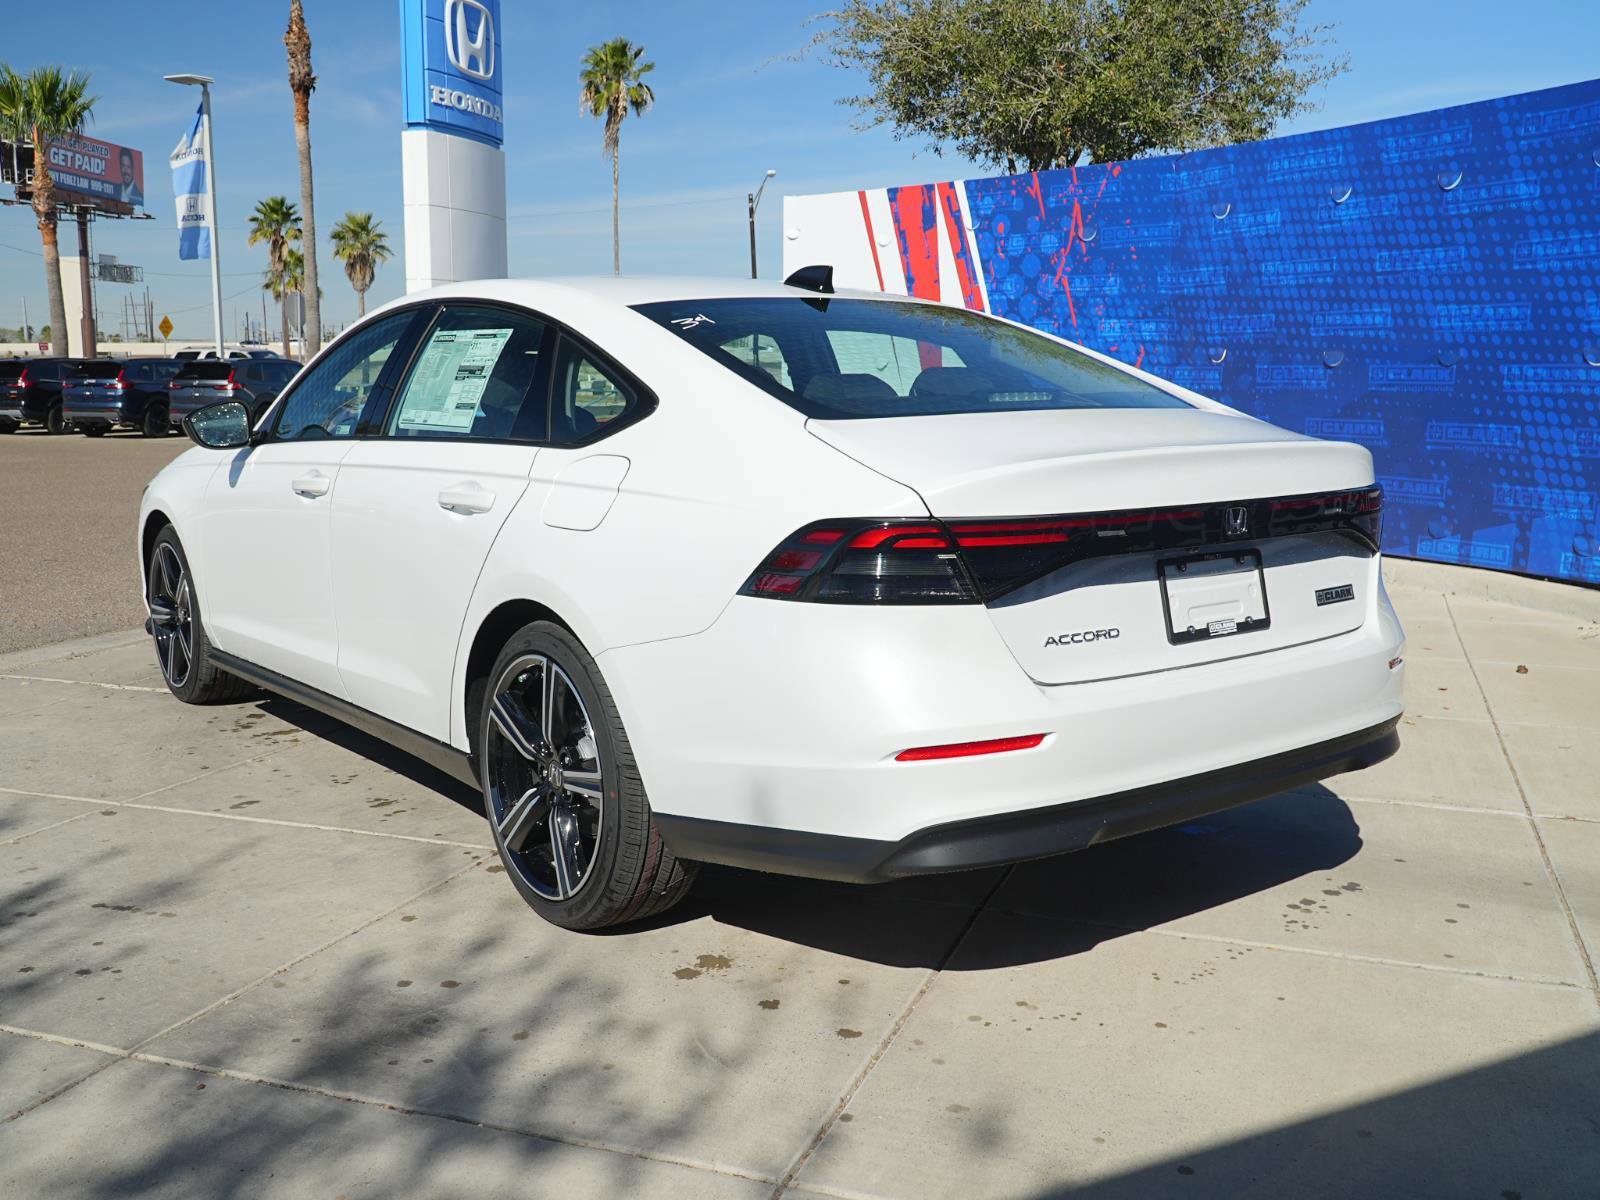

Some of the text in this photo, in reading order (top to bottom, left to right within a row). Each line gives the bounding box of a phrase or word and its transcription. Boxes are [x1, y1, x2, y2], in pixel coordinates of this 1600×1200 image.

[430, 85, 502, 122] HONDA
[50, 147, 105, 176] GET PAID!
[1386, 368, 1450, 380] CLARK
[1322, 421, 1379, 435] CLARK
[1446, 427, 1517, 444] CLARK
[1325, 587, 1352, 601] CLARK
[1044, 627, 1120, 648] ACCORD
